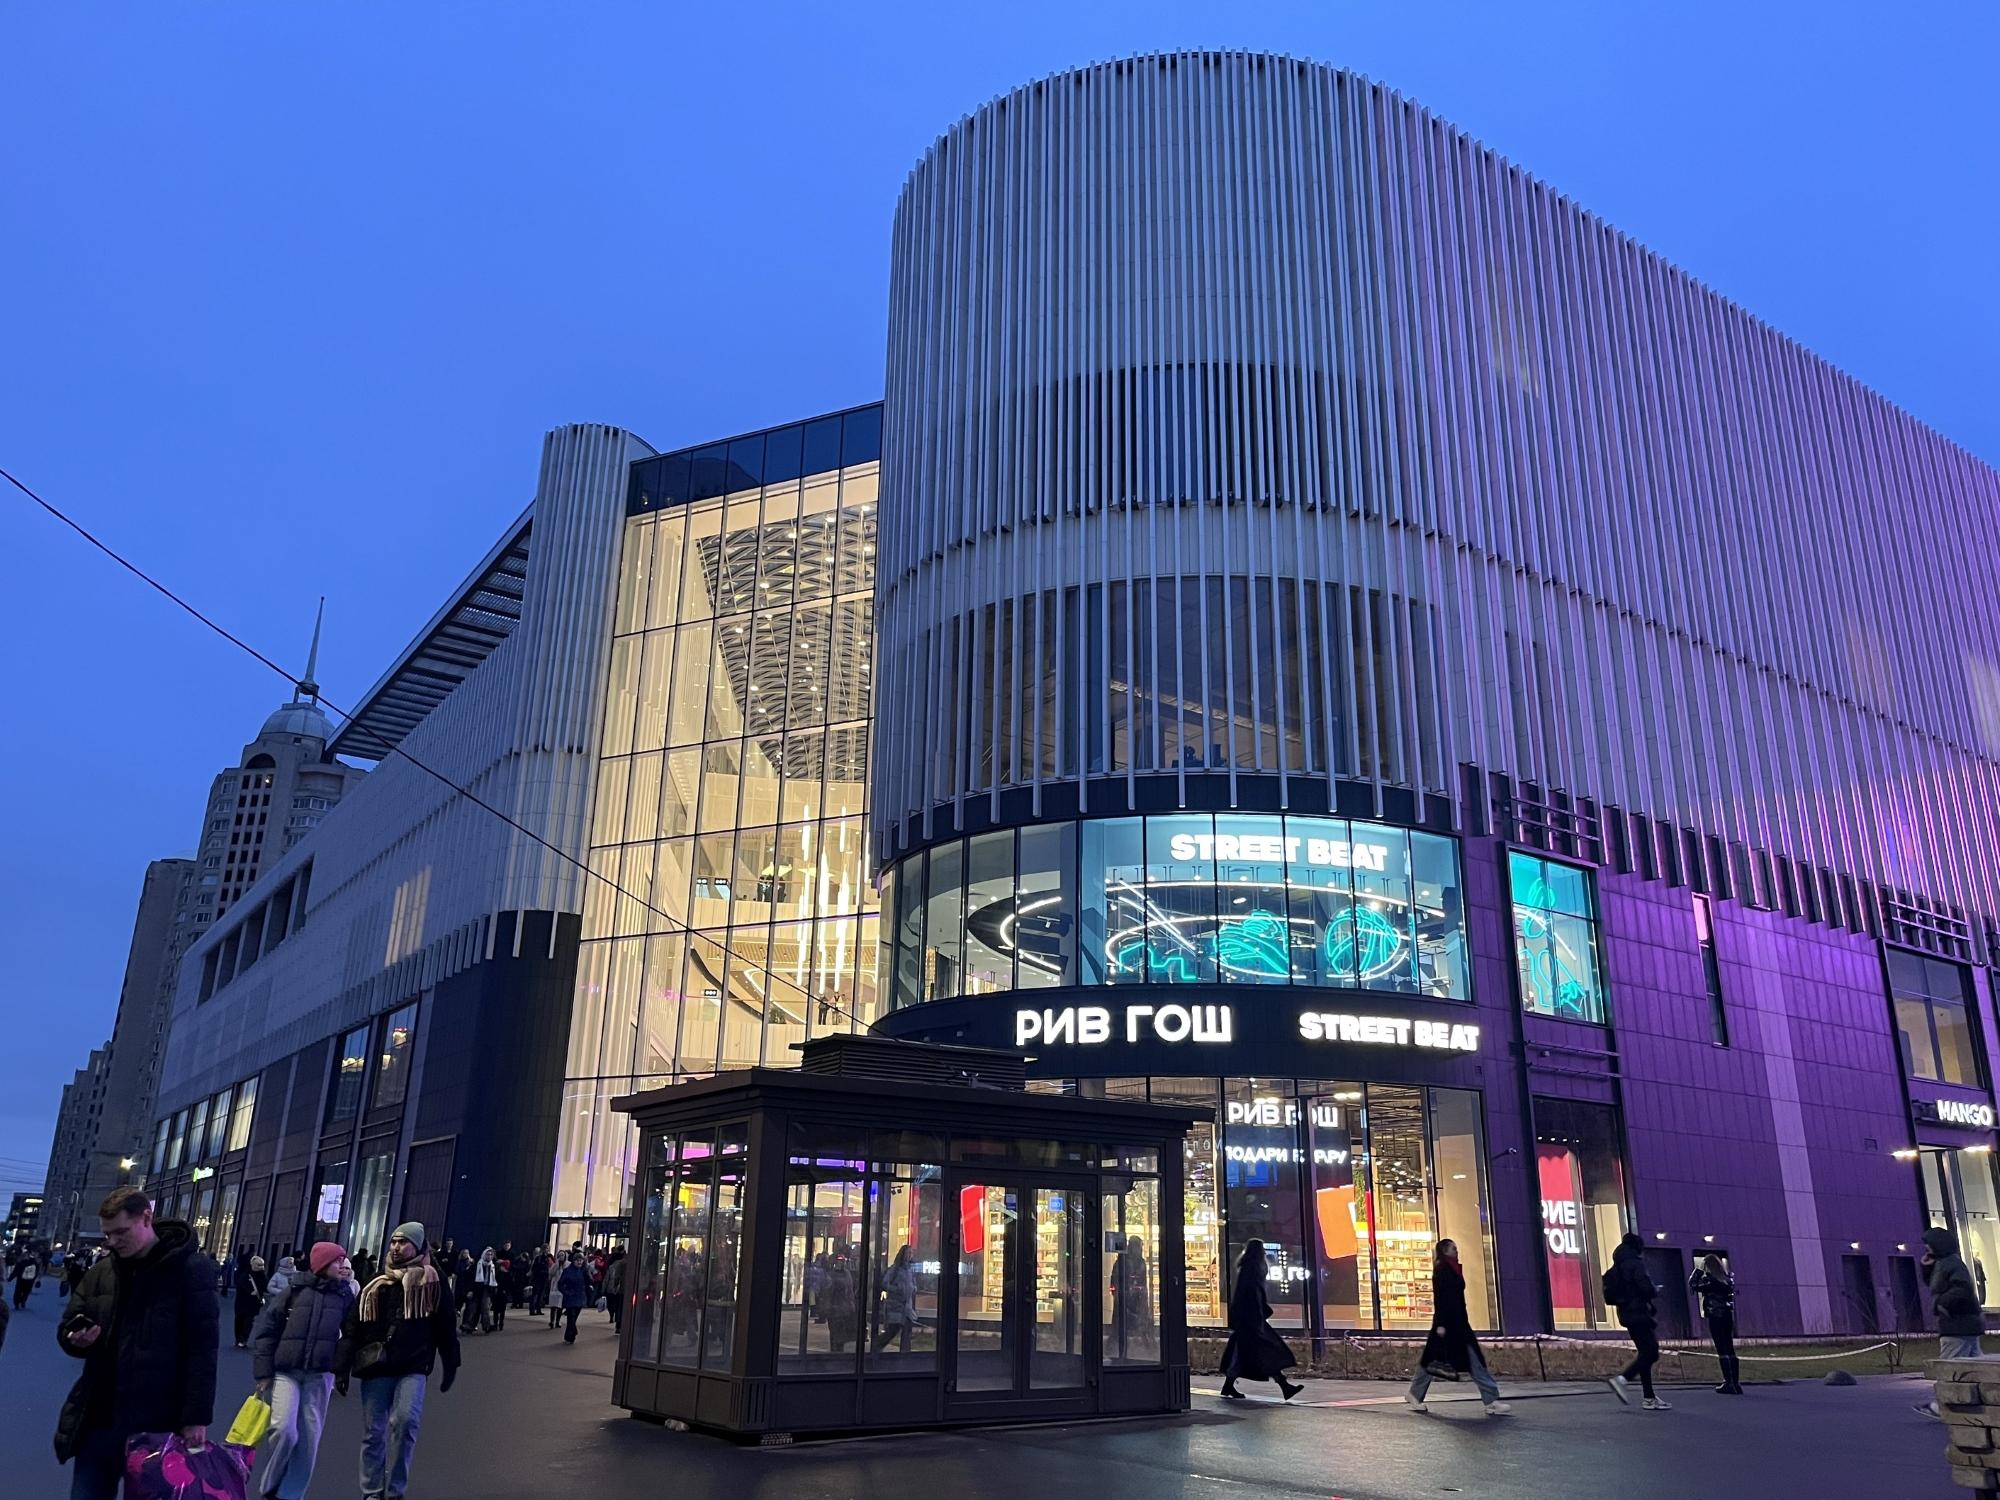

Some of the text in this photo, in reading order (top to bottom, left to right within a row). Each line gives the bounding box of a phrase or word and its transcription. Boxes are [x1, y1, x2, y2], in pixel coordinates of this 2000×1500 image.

[1170, 833, 1388, 871] STREET BEAT
[1016, 1004, 1232, 1046] РИВ ГОШ
[1299, 1012, 1480, 1051] STREET BEAT
[1227, 1102, 1280, 1124] РИВ
[1937, 1099, 1992, 1126] MANGO
